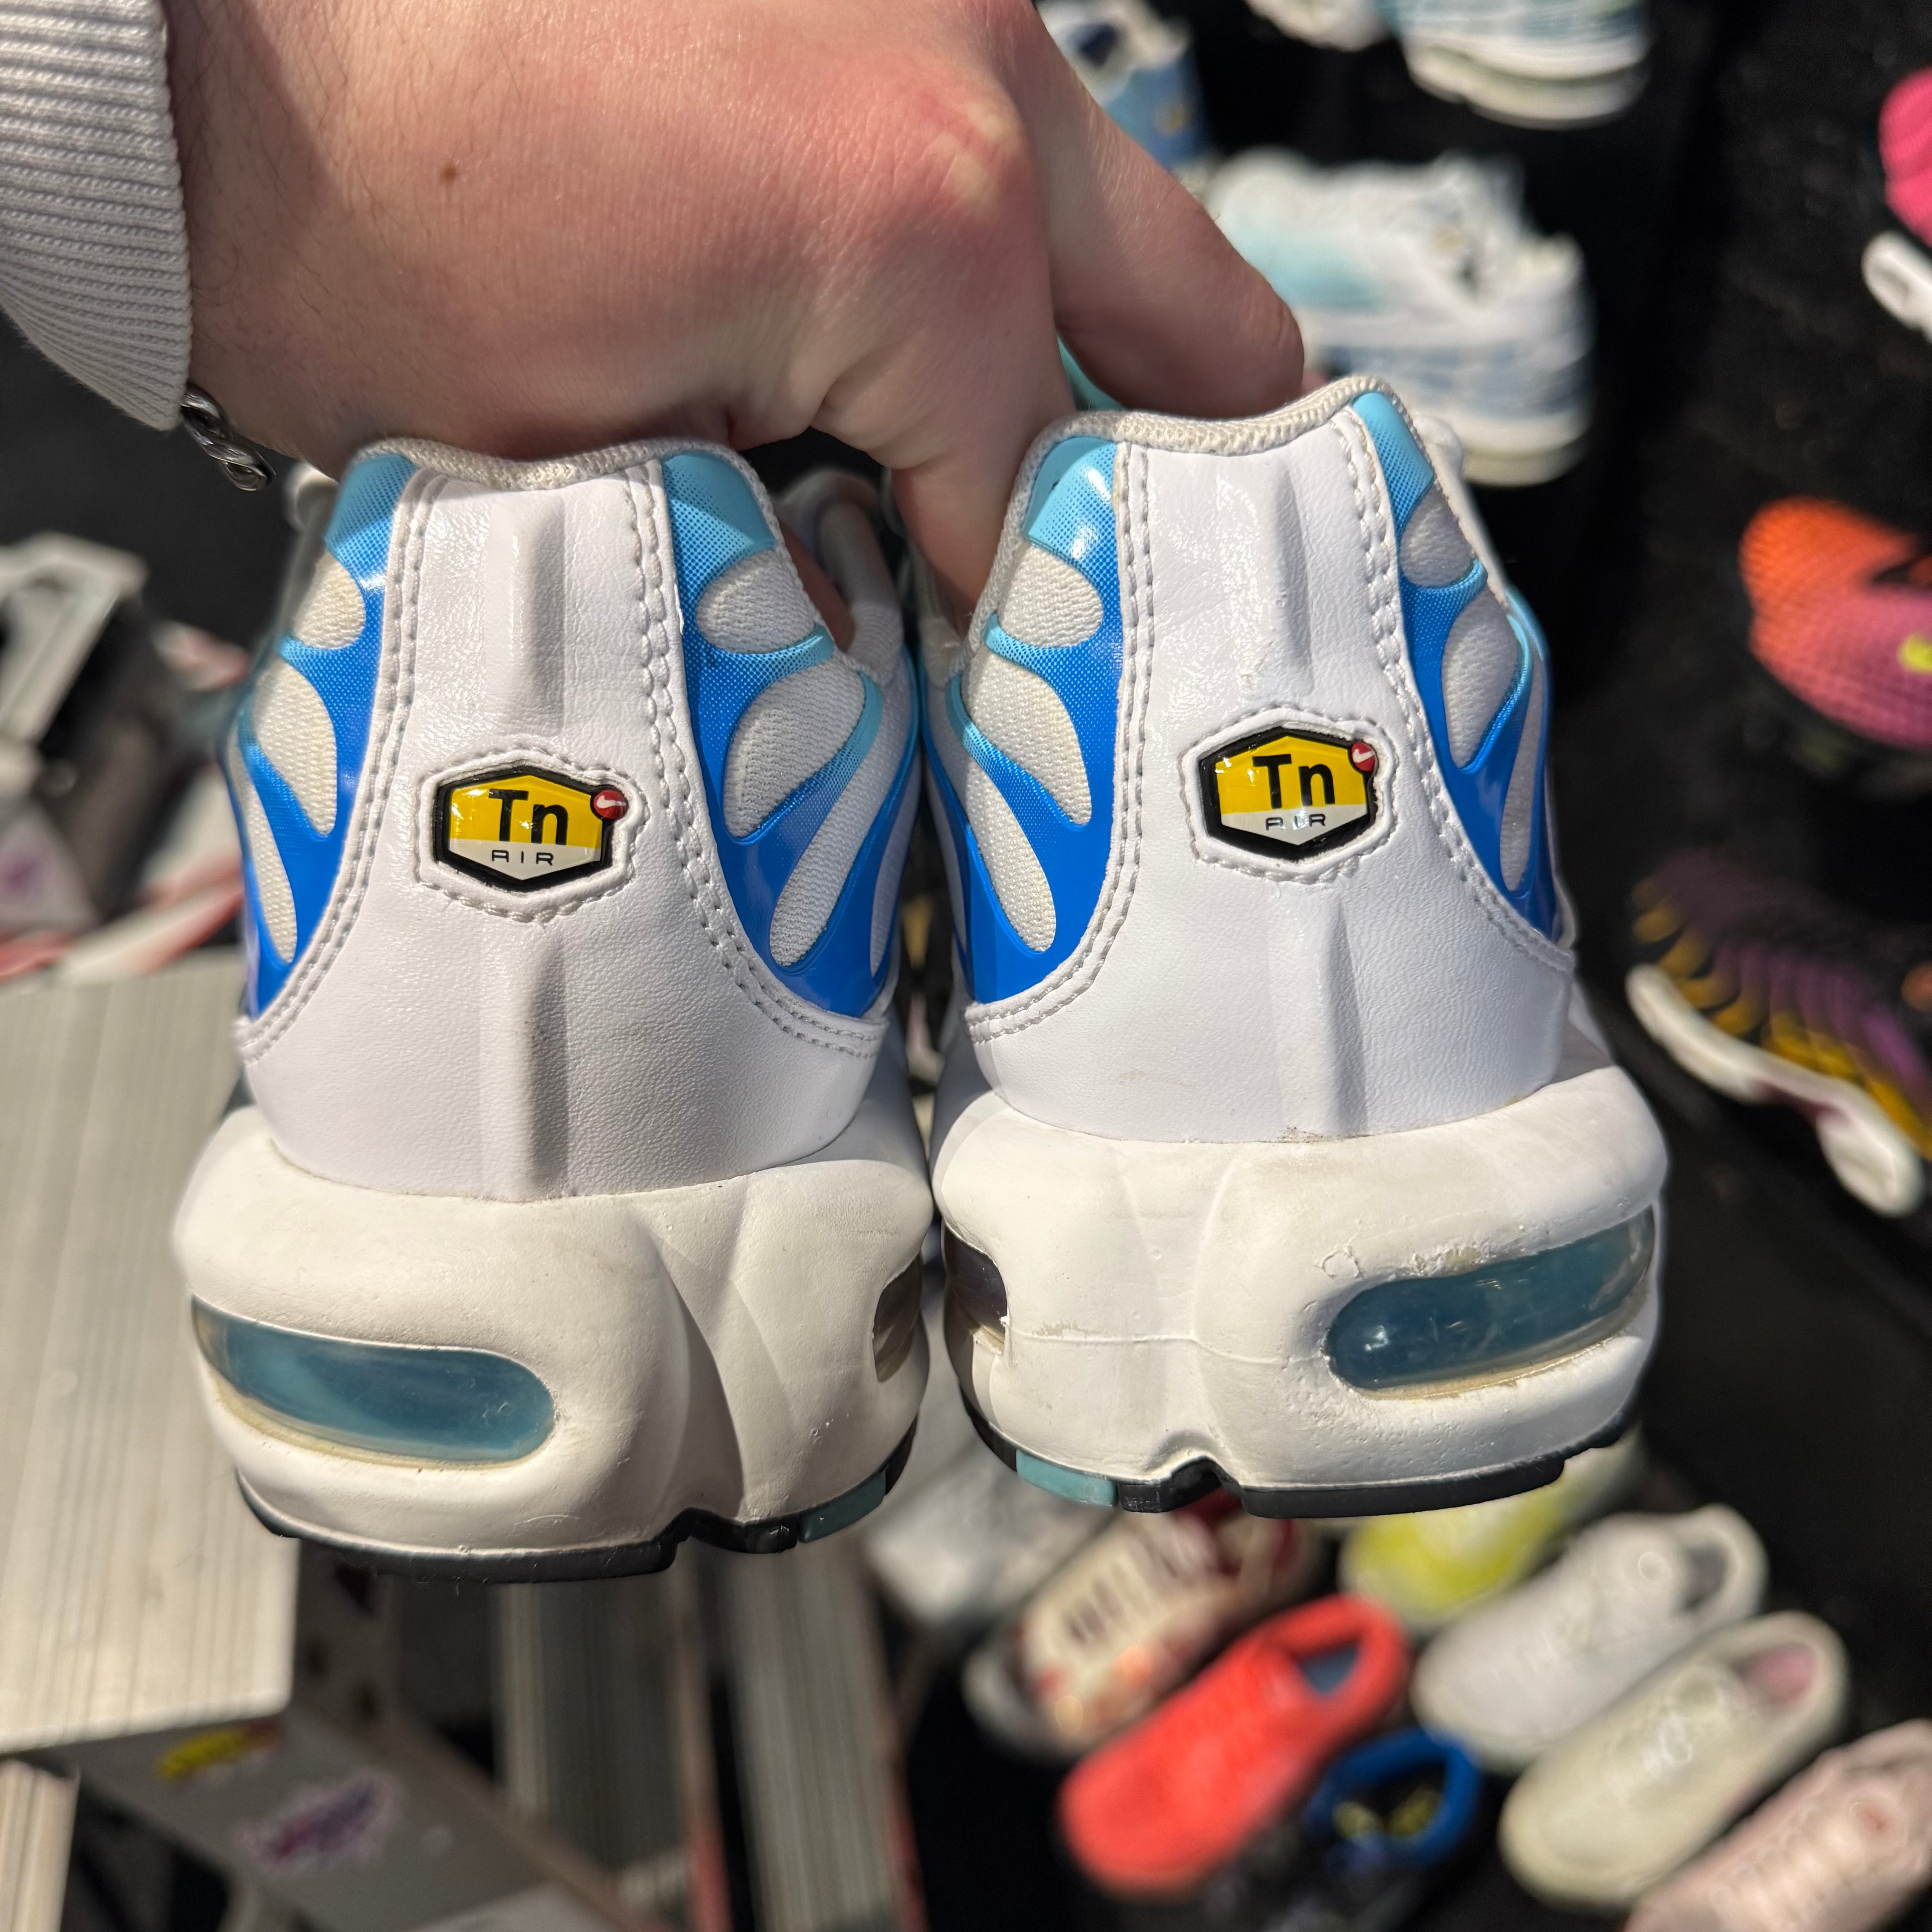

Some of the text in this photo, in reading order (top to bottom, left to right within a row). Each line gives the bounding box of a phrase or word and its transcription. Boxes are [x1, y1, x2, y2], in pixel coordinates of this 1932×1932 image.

[1253, 754, 1336, 810] Tn
[488, 788, 569, 846] Tn
[1265, 814, 1326, 831] AIR
[492, 849, 554, 866] AIR
